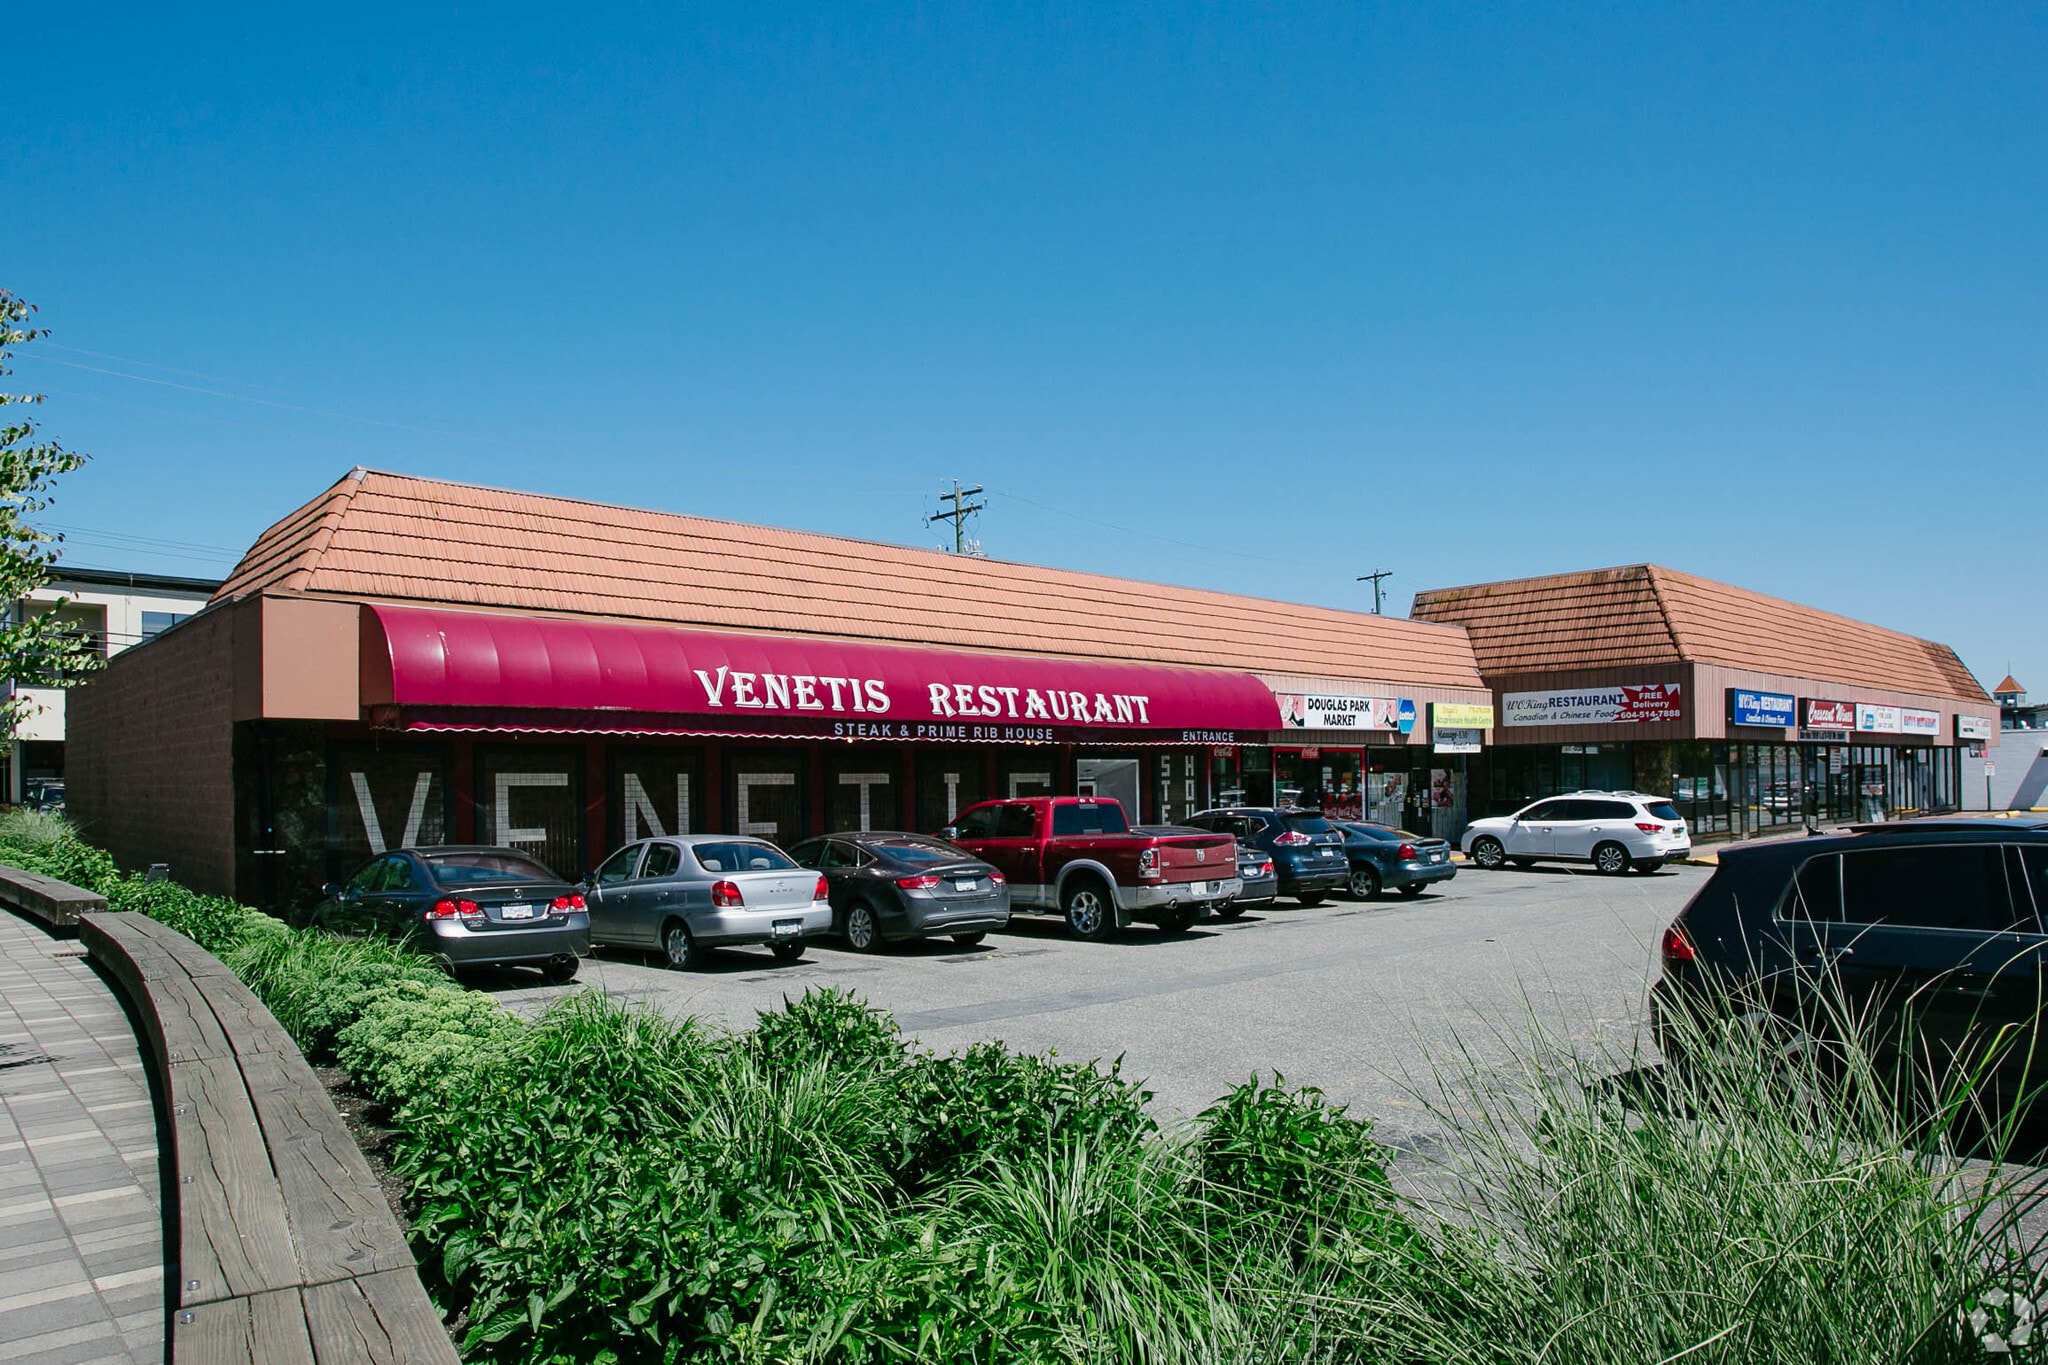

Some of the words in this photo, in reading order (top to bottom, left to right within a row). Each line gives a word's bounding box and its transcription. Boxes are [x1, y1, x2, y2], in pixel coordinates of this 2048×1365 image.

[693, 665, 891, 713] VENETIS
[927, 683, 1150, 725] RESTAURANT
[1549, 693, 1624, 708] RESTAURANT
[1308, 698, 1347, 711] DOUGLAS
[1350, 700, 1370, 712] PARK
[1633, 700, 1669, 708] Delivery
[1324, 714, 1356, 726] MARKET
[1513, 713, 1548, 721] Canadian
[1551, 712, 1557, 720] &
[1560, 711, 1591, 719] Chinese
[1595, 709, 1616, 718] Food
[1621, 710, 1680, 719] 604-514-7888
[834, 722, 891, 736] STEAK
[900, 725, 909, 737] &
[918, 724, 966, 738] PRIME
[974, 727, 998, 739] RIB
[1006, 728, 1053, 740] HOUSE
[1183, 731, 1234, 742] ENTRANCE
